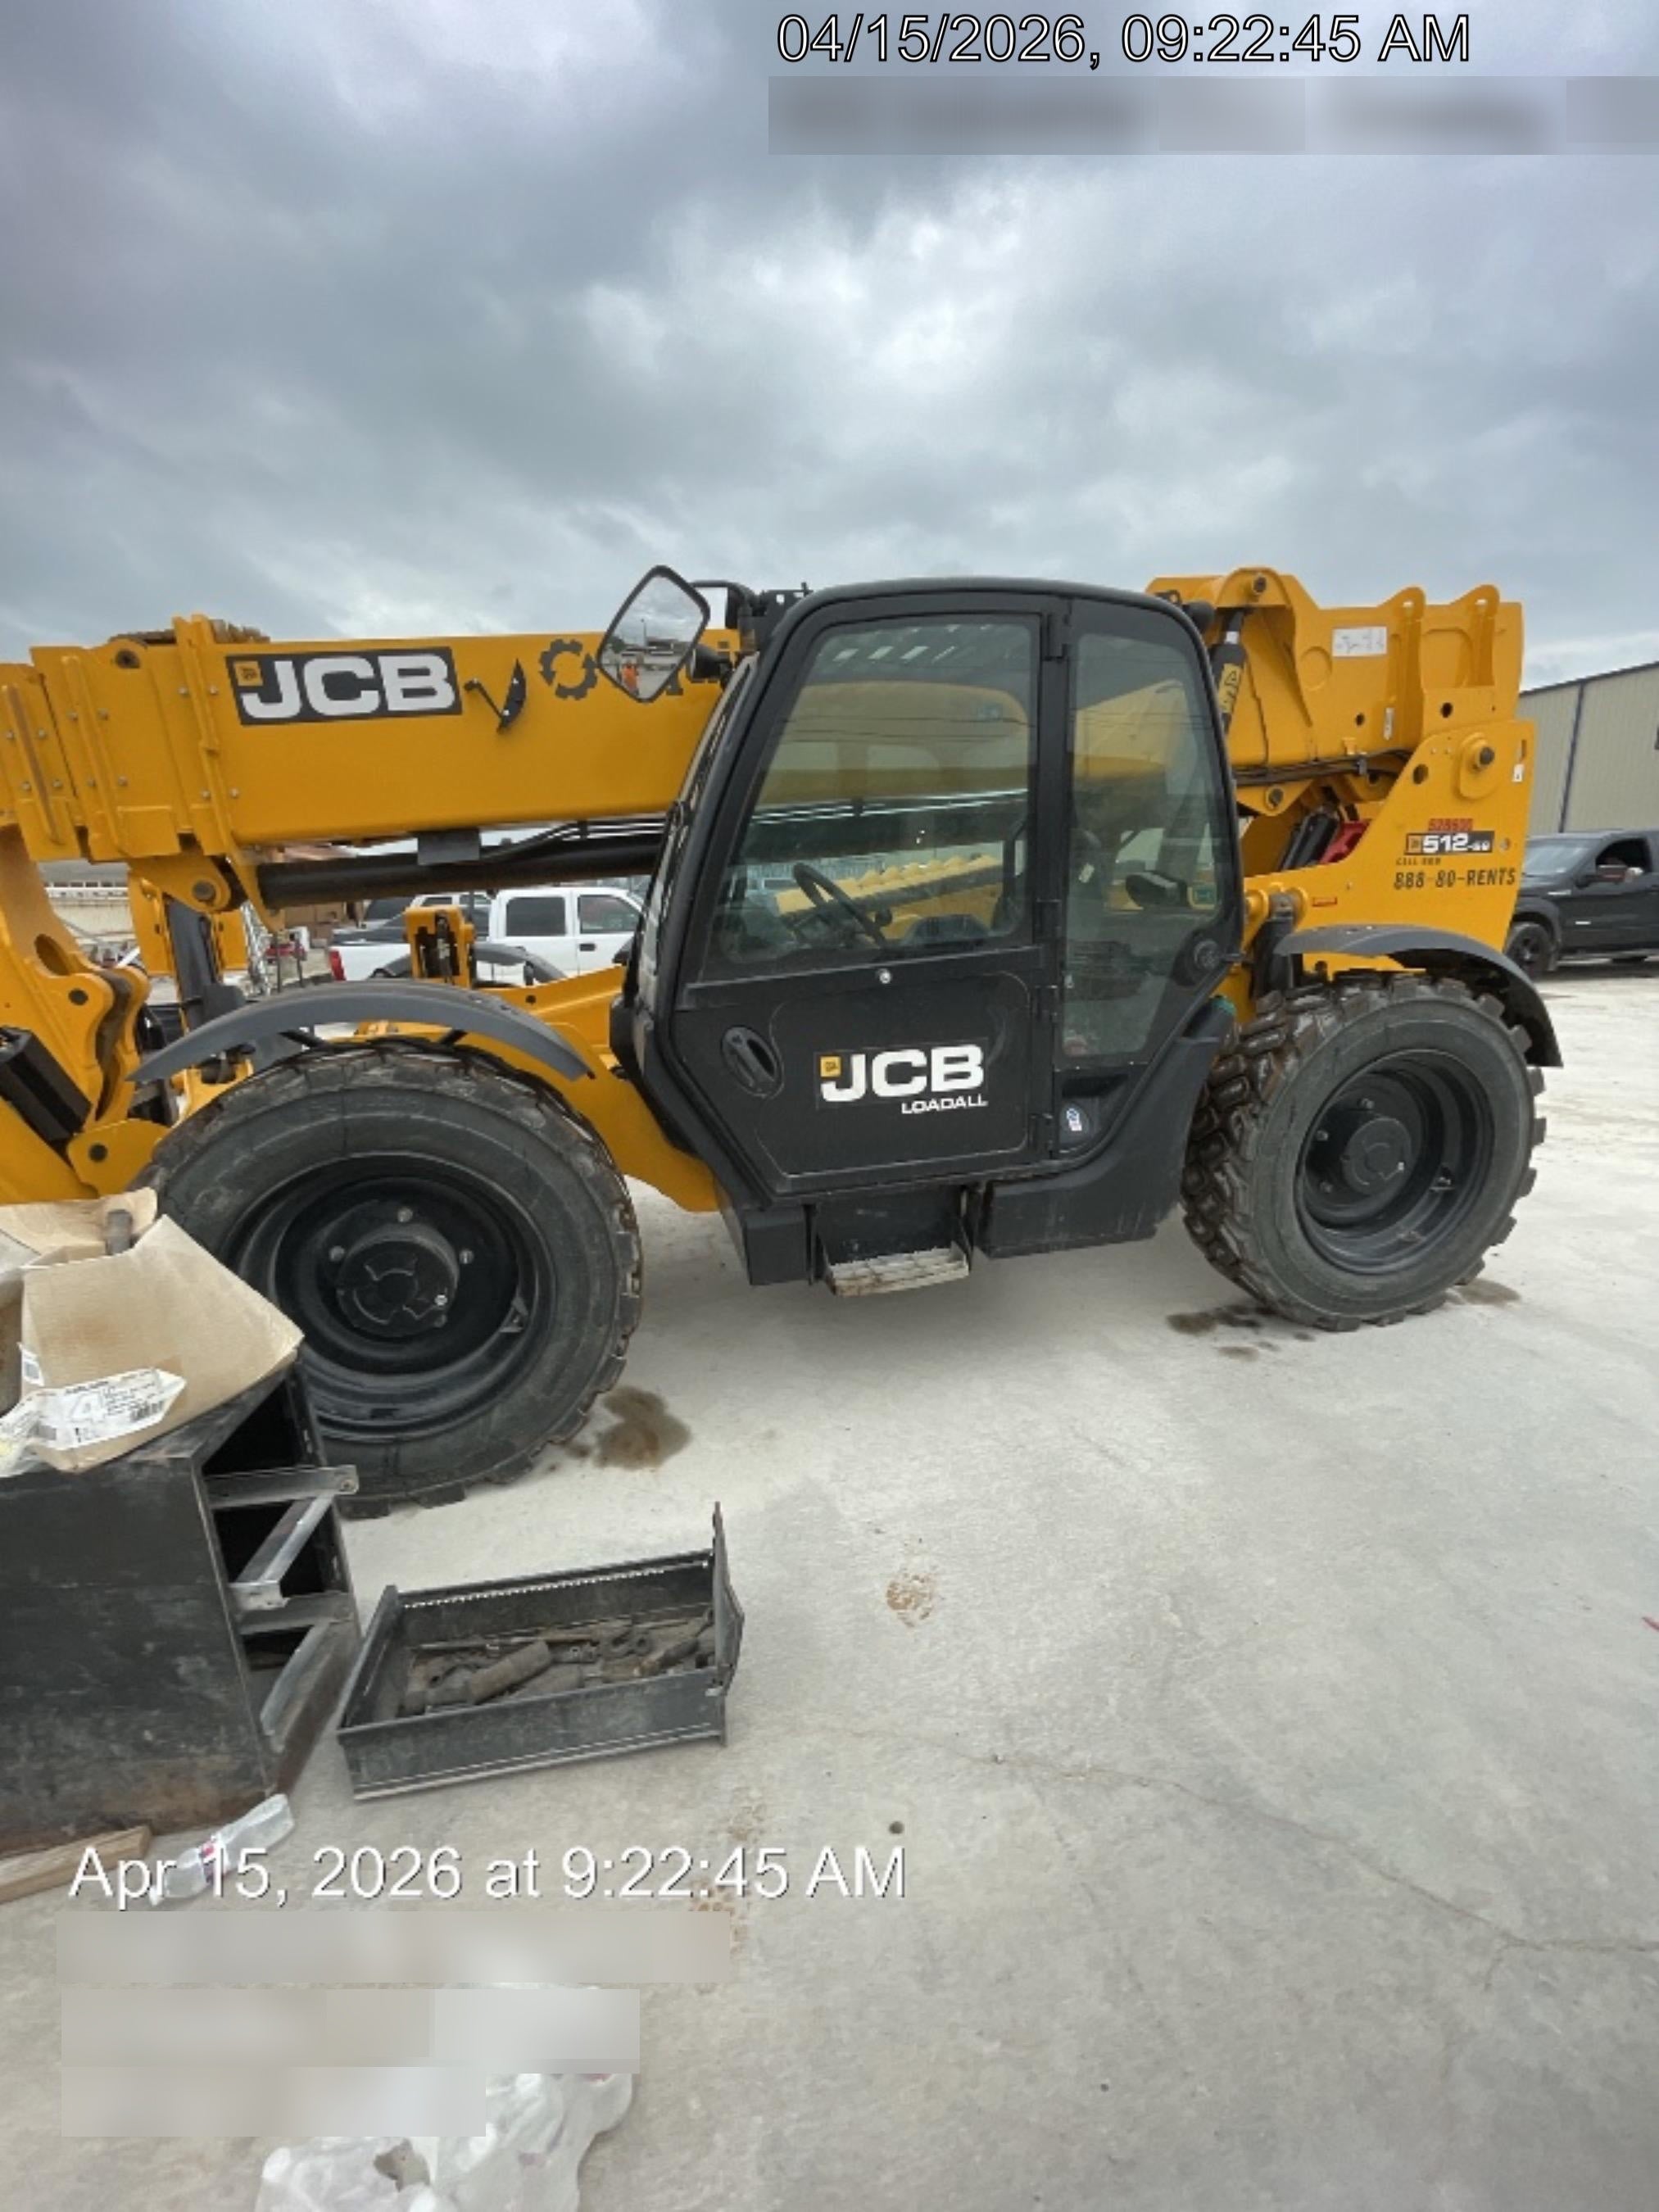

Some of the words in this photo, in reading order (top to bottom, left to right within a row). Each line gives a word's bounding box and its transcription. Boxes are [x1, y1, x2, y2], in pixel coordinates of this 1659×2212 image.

[238, 652, 456, 719] JCB
[820, 1044, 985, 1102] JCB
[900, 1093, 989, 1115] LOADALL
